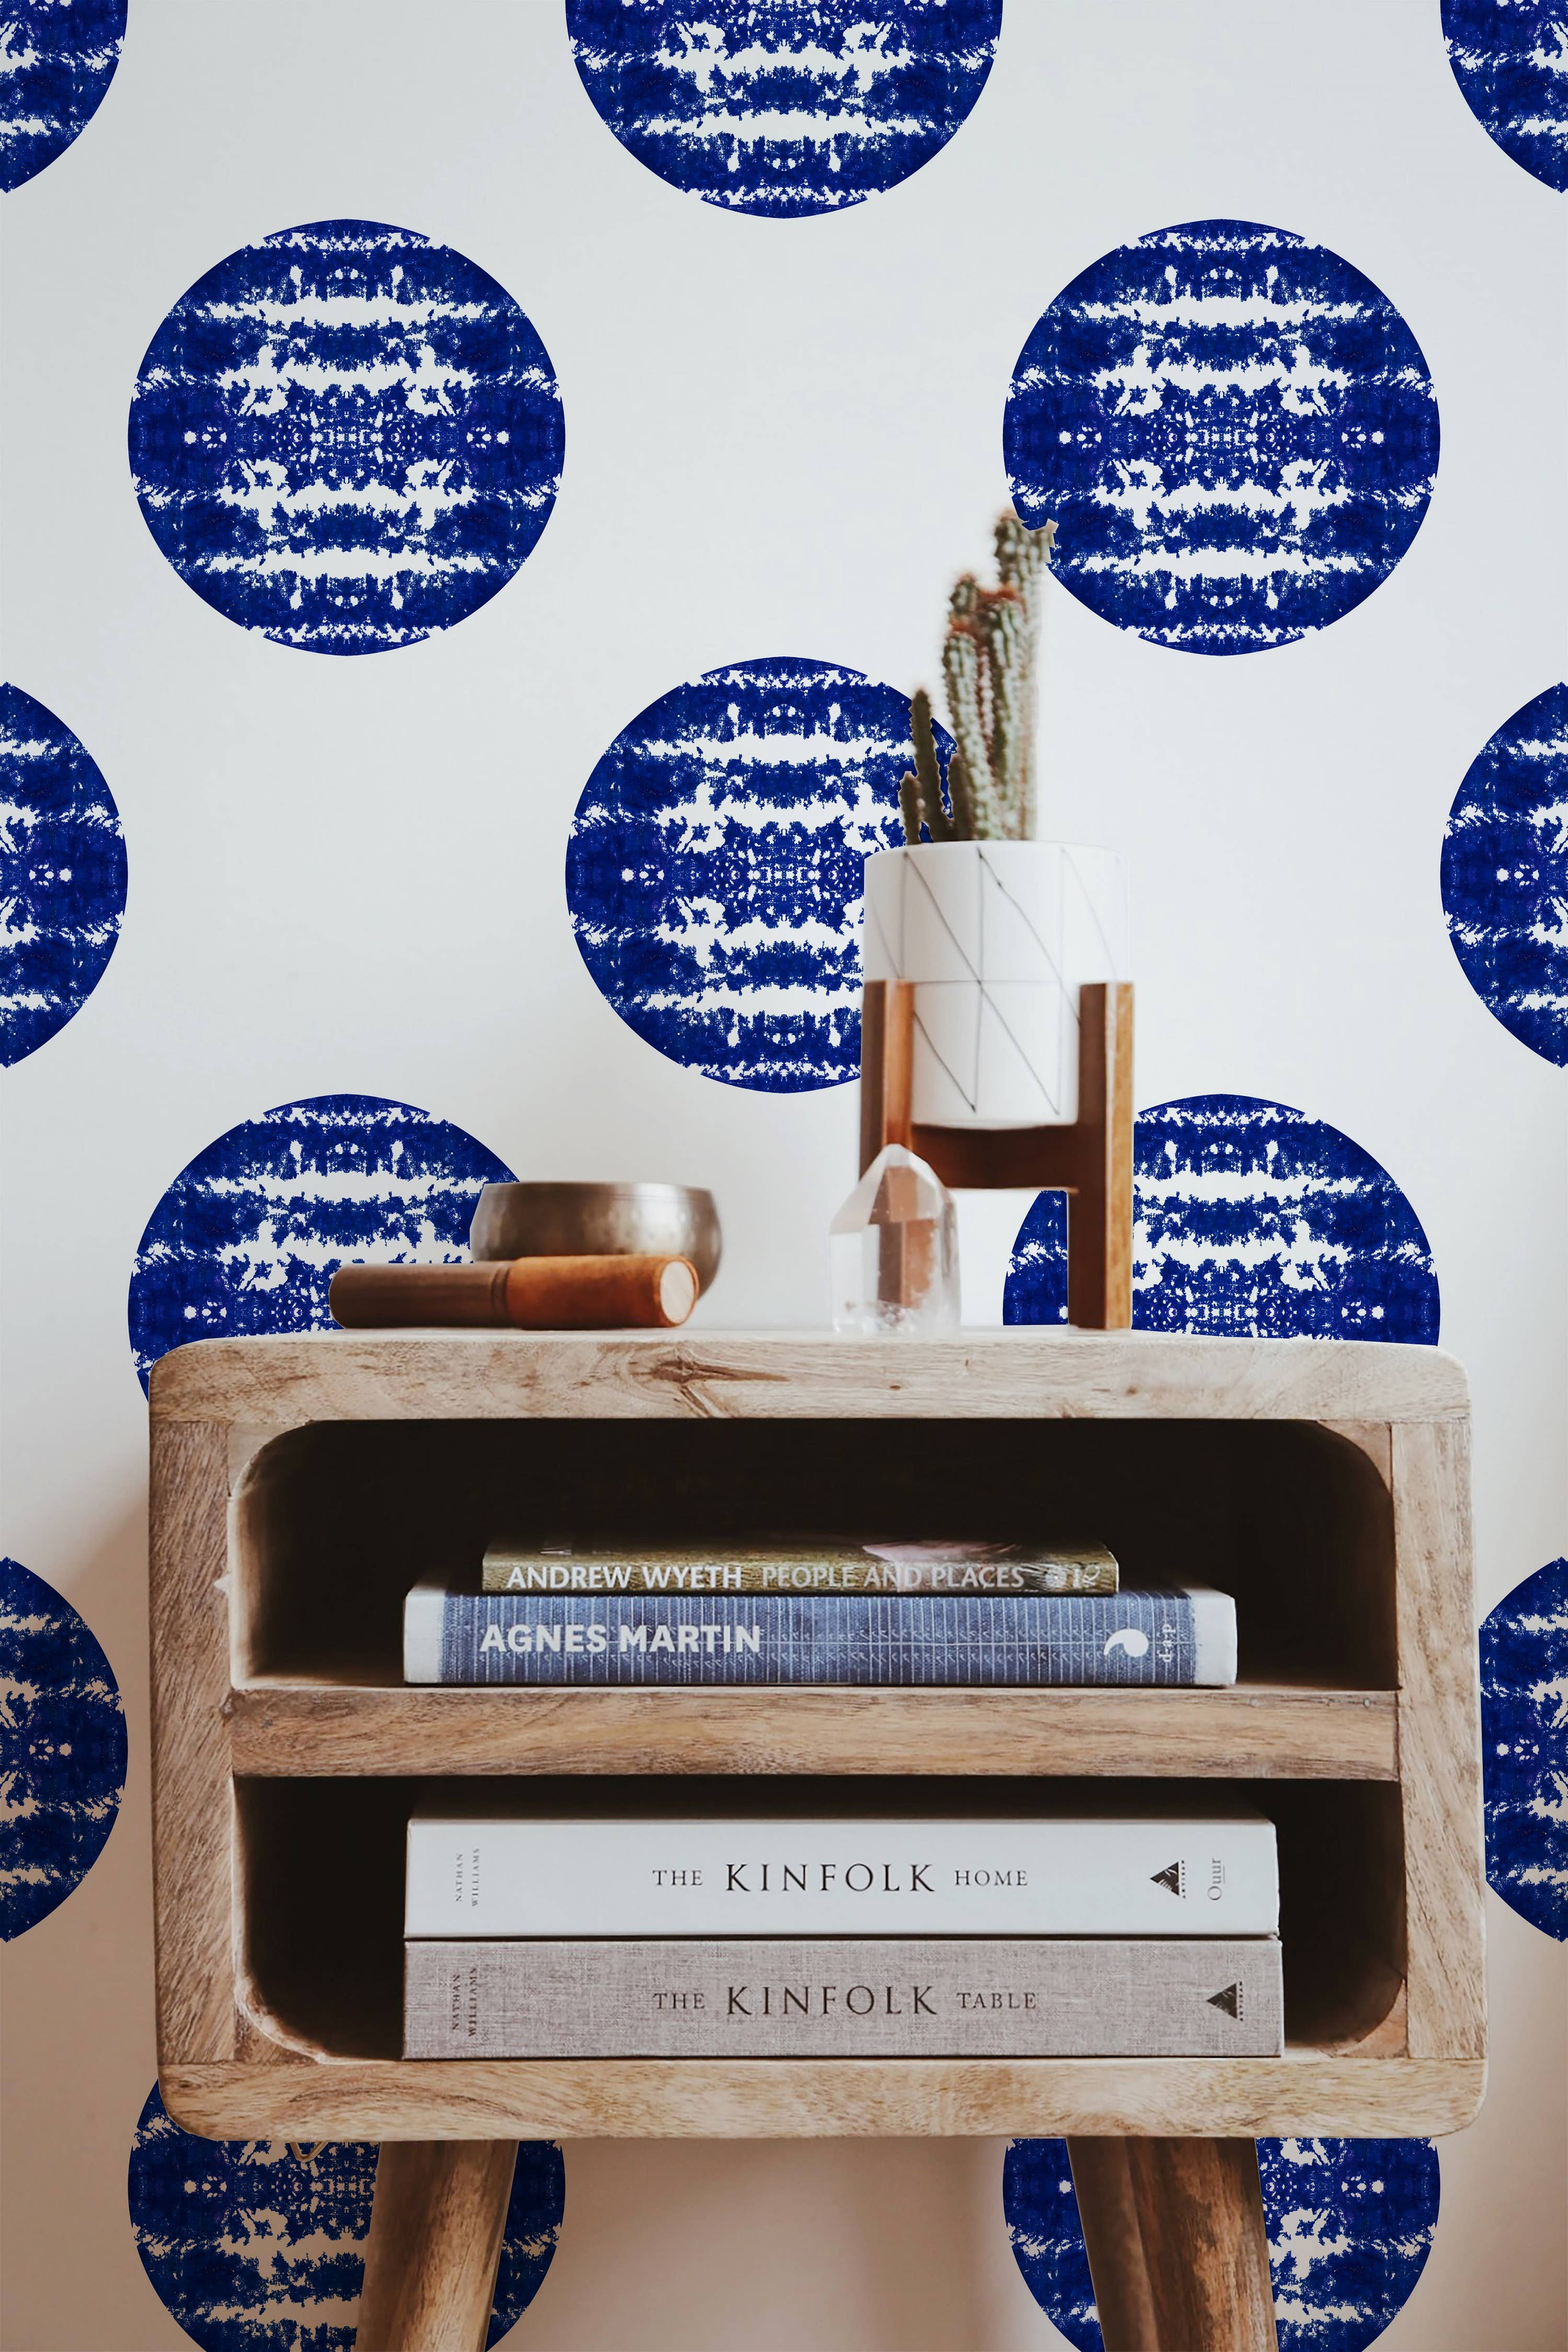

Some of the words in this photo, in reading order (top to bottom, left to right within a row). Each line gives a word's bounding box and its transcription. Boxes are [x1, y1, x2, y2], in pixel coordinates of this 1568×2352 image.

[505, 1565, 632, 1589] ANDREW
[641, 1565, 742, 1589] WYETH
[762, 1566, 857, 1589] PEOPLE
[862, 1566, 923, 1589] AND
[931, 1566, 1026, 1589] PLACES
[479, 1623, 608, 1653] AGNES
[620, 1623, 762, 1653] MARTIN
[455, 1853, 463, 1902] NATHAN
[471, 1848, 480, 1907] WILLIAMS
[651, 1869, 704, 1886] THE
[724, 1863, 936, 1892] KINFOLK
[954, 1869, 1029, 1887] HOME
[452, 1973, 461, 2031] NATHAN
[468, 1967, 478, 2037] WILLIAMS
[653, 1992, 706, 2010] THE
[727, 1985, 938, 2016] KINFOLK
[956, 1991, 1037, 2010] TABLE
